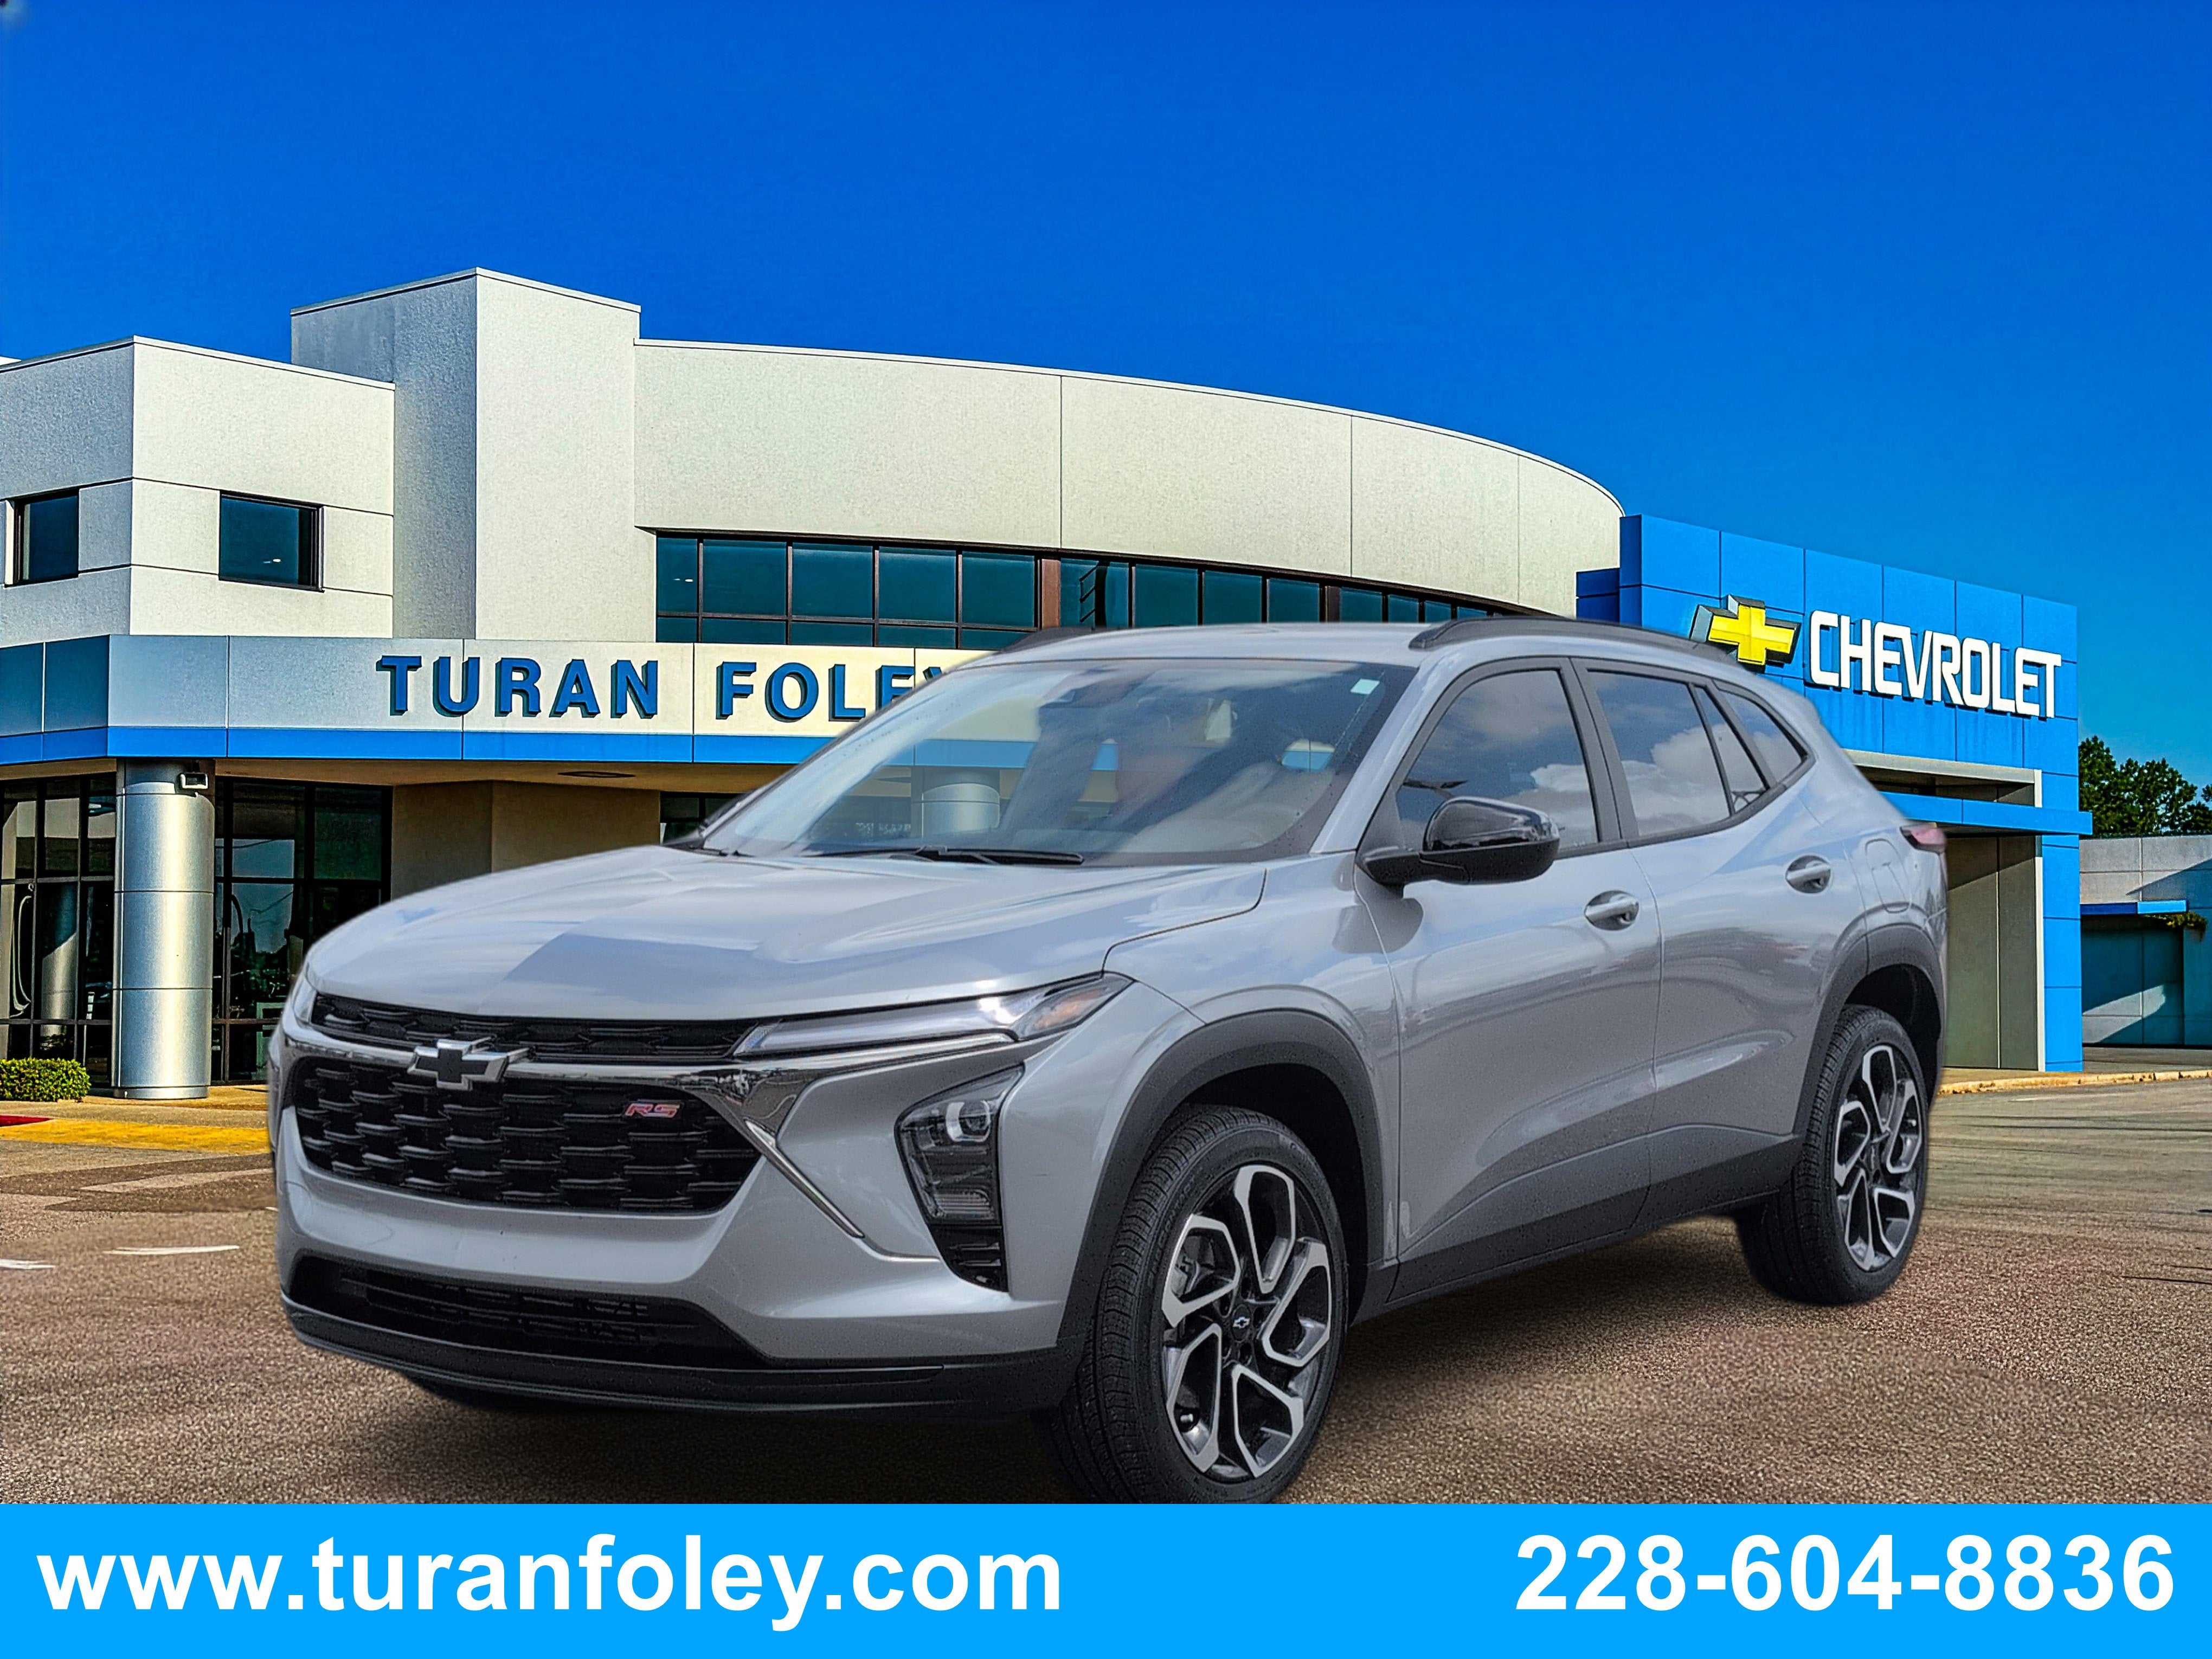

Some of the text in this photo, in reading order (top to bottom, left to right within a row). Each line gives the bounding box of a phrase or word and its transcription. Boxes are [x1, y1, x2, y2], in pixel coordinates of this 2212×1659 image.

[376, 655, 942, 722] TURAN FOLE
[1809, 609, 2062, 719] CHEVROLET
[624, 1103, 680, 1118] RS
